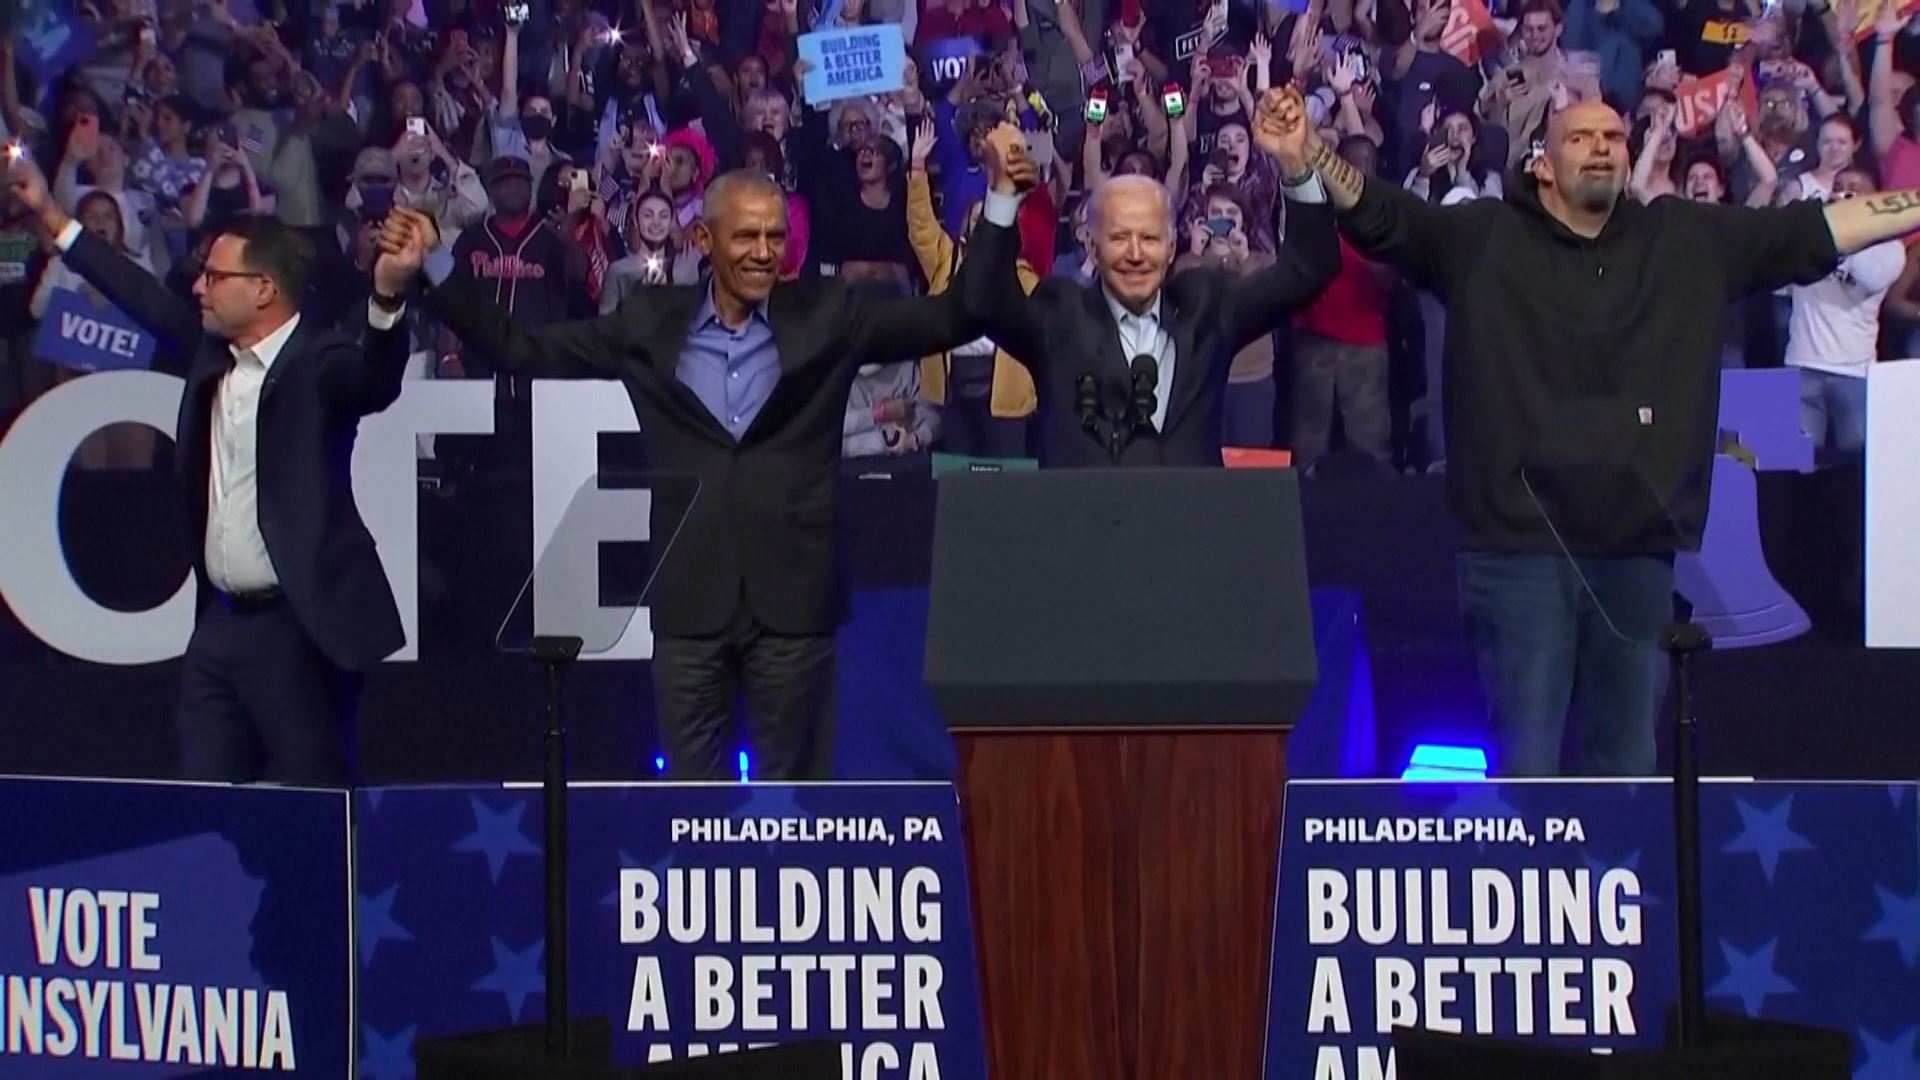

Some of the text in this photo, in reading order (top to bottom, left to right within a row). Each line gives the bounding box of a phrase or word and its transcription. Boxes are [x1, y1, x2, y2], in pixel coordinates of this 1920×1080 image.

[821, 34, 881, 54] BUILDING
[824, 50, 882, 70] A BETTER
[827, 66, 884, 86] AMERICA
[61, 311, 140, 358] VOTE!
[671, 817, 943, 846] PHILADELPHIA, PA
[1305, 817, 1585, 847] PHILADELPHIA, PA
[28, 886, 161, 971] VOTE
[619, 866, 942, 944] BUILDING
[1307, 867, 1642, 945] BUILDING
[0, 975, 296, 1071] NSYLVANIA
[627, 954, 945, 1031] A BETTER
[1306, 956, 1637, 1035] A BETTER
